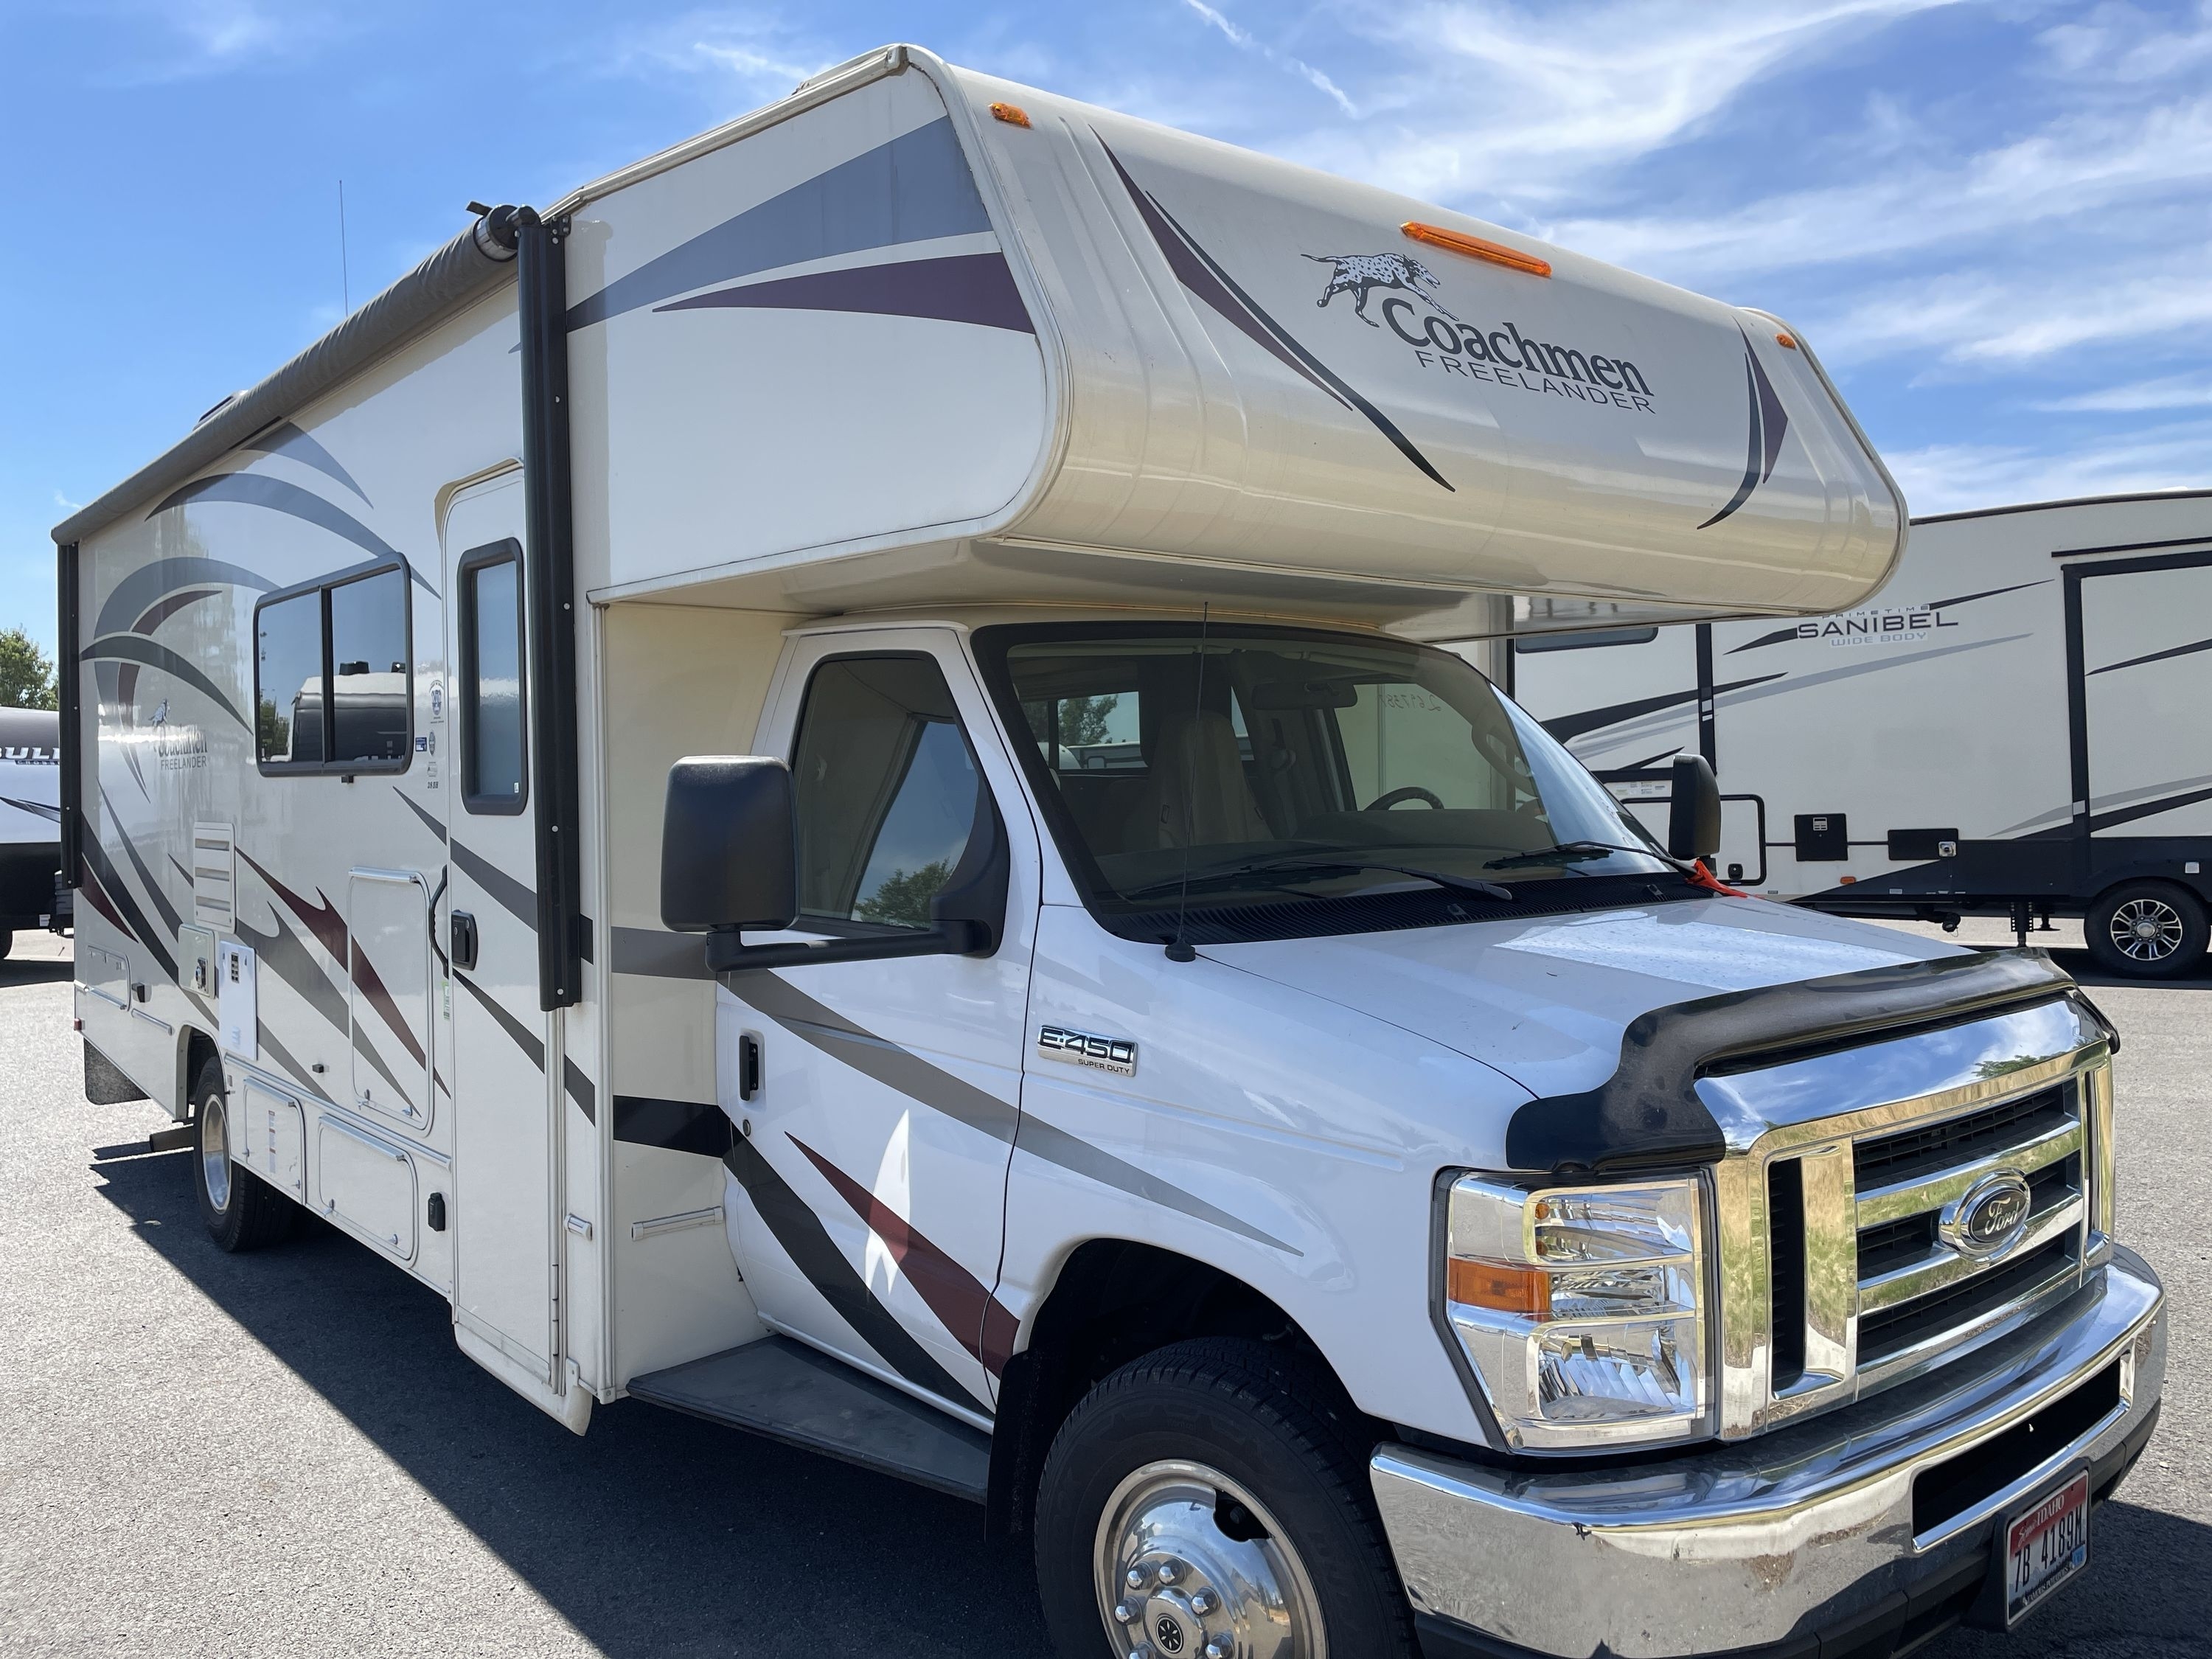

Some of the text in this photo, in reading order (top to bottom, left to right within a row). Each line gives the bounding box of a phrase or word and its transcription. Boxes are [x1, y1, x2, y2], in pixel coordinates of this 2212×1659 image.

[1381, 297, 1655, 397] Coachmen
[1415, 350, 1656, 414] FREELANDER
[1798, 611, 1959, 639] SANIBEL
[1831, 632, 1927, 647] WIDE BODY
[0, 747, 60, 759] UL
[161, 756, 207, 771] FREELANDER
[1078, 1059, 1130, 1074] SUPER DUTY
[1984, 1197, 2020, 1235] Ford
[2037, 1494, 2065, 1526] IDAHO
